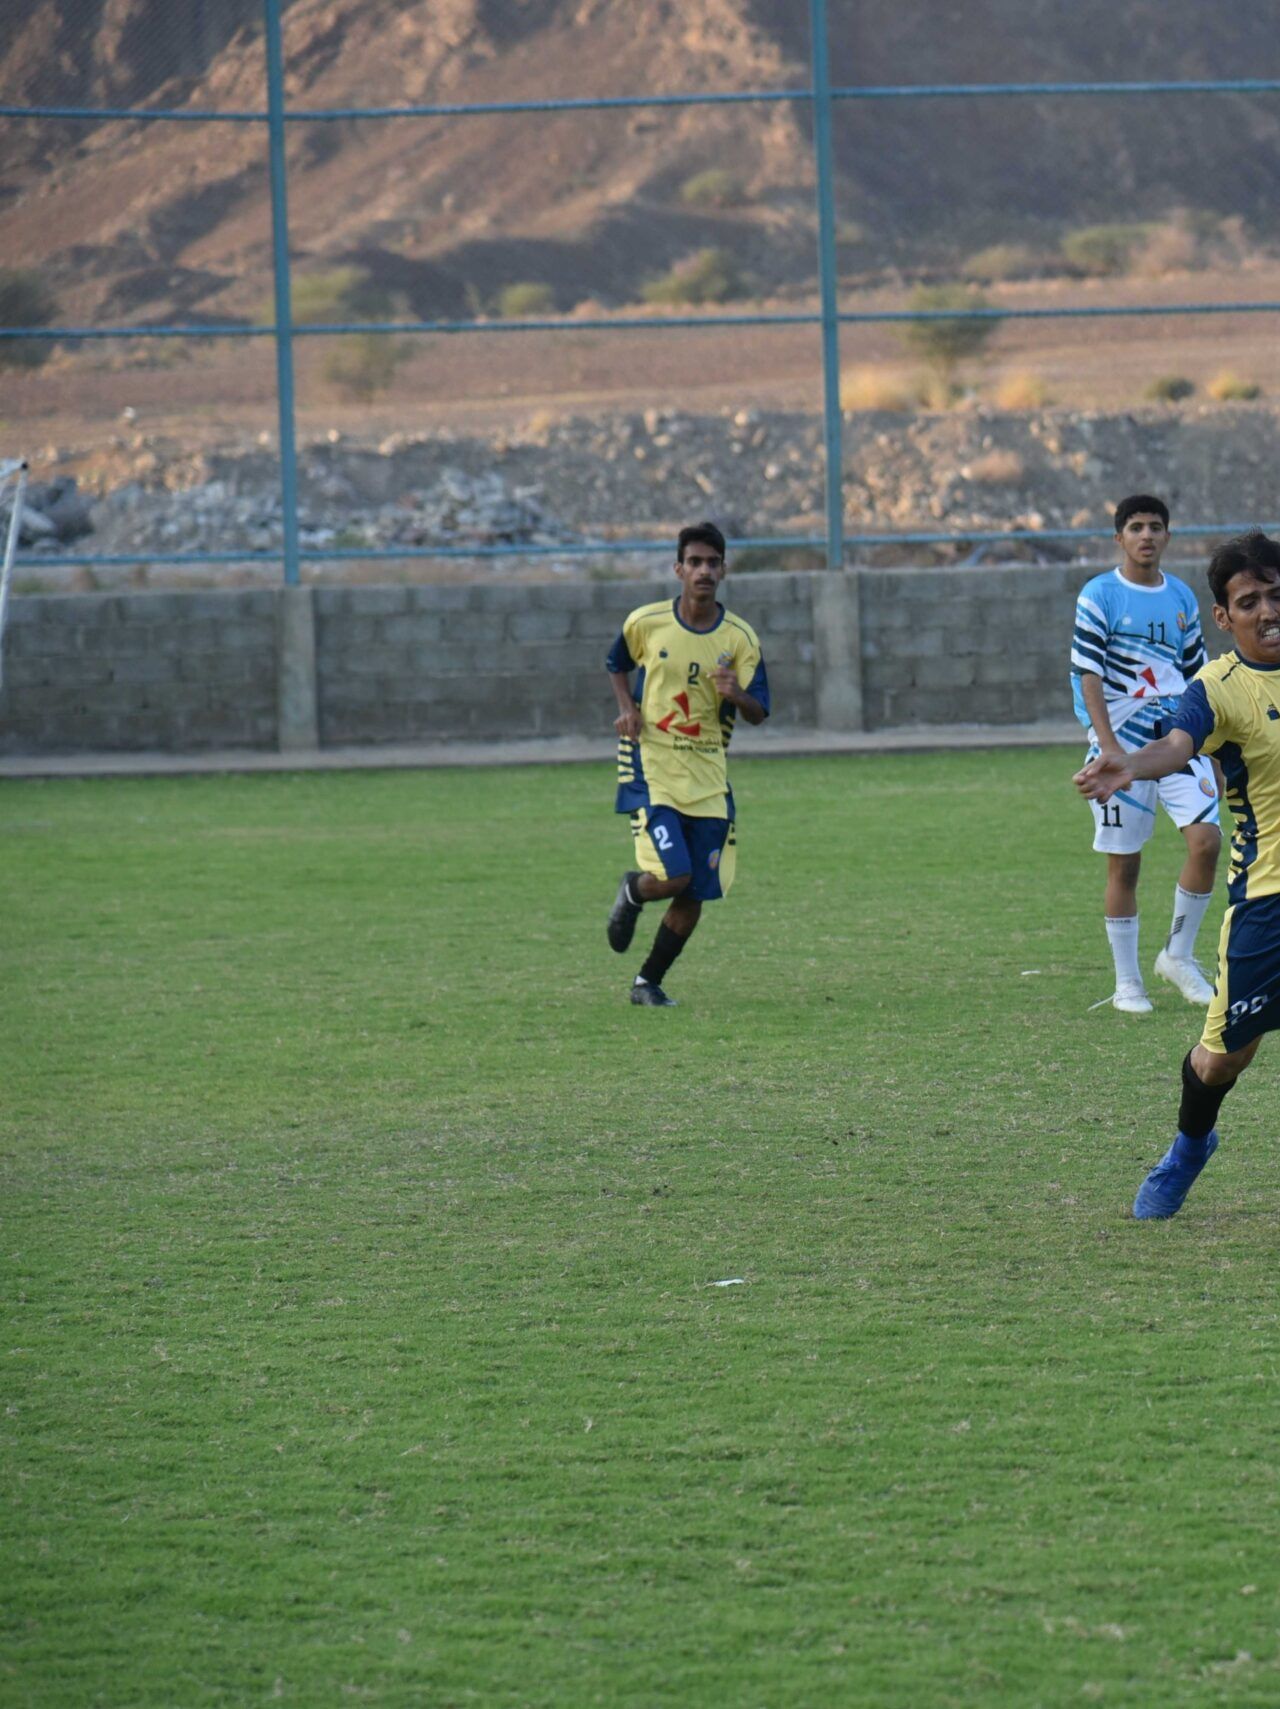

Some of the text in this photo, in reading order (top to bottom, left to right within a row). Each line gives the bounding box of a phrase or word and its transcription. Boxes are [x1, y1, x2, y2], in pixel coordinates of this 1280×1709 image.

[1147, 621, 1166, 645] 11
[687, 661, 700, 686] 2
[1101, 804, 1123, 828] 11
[653, 824, 674, 850] 2
